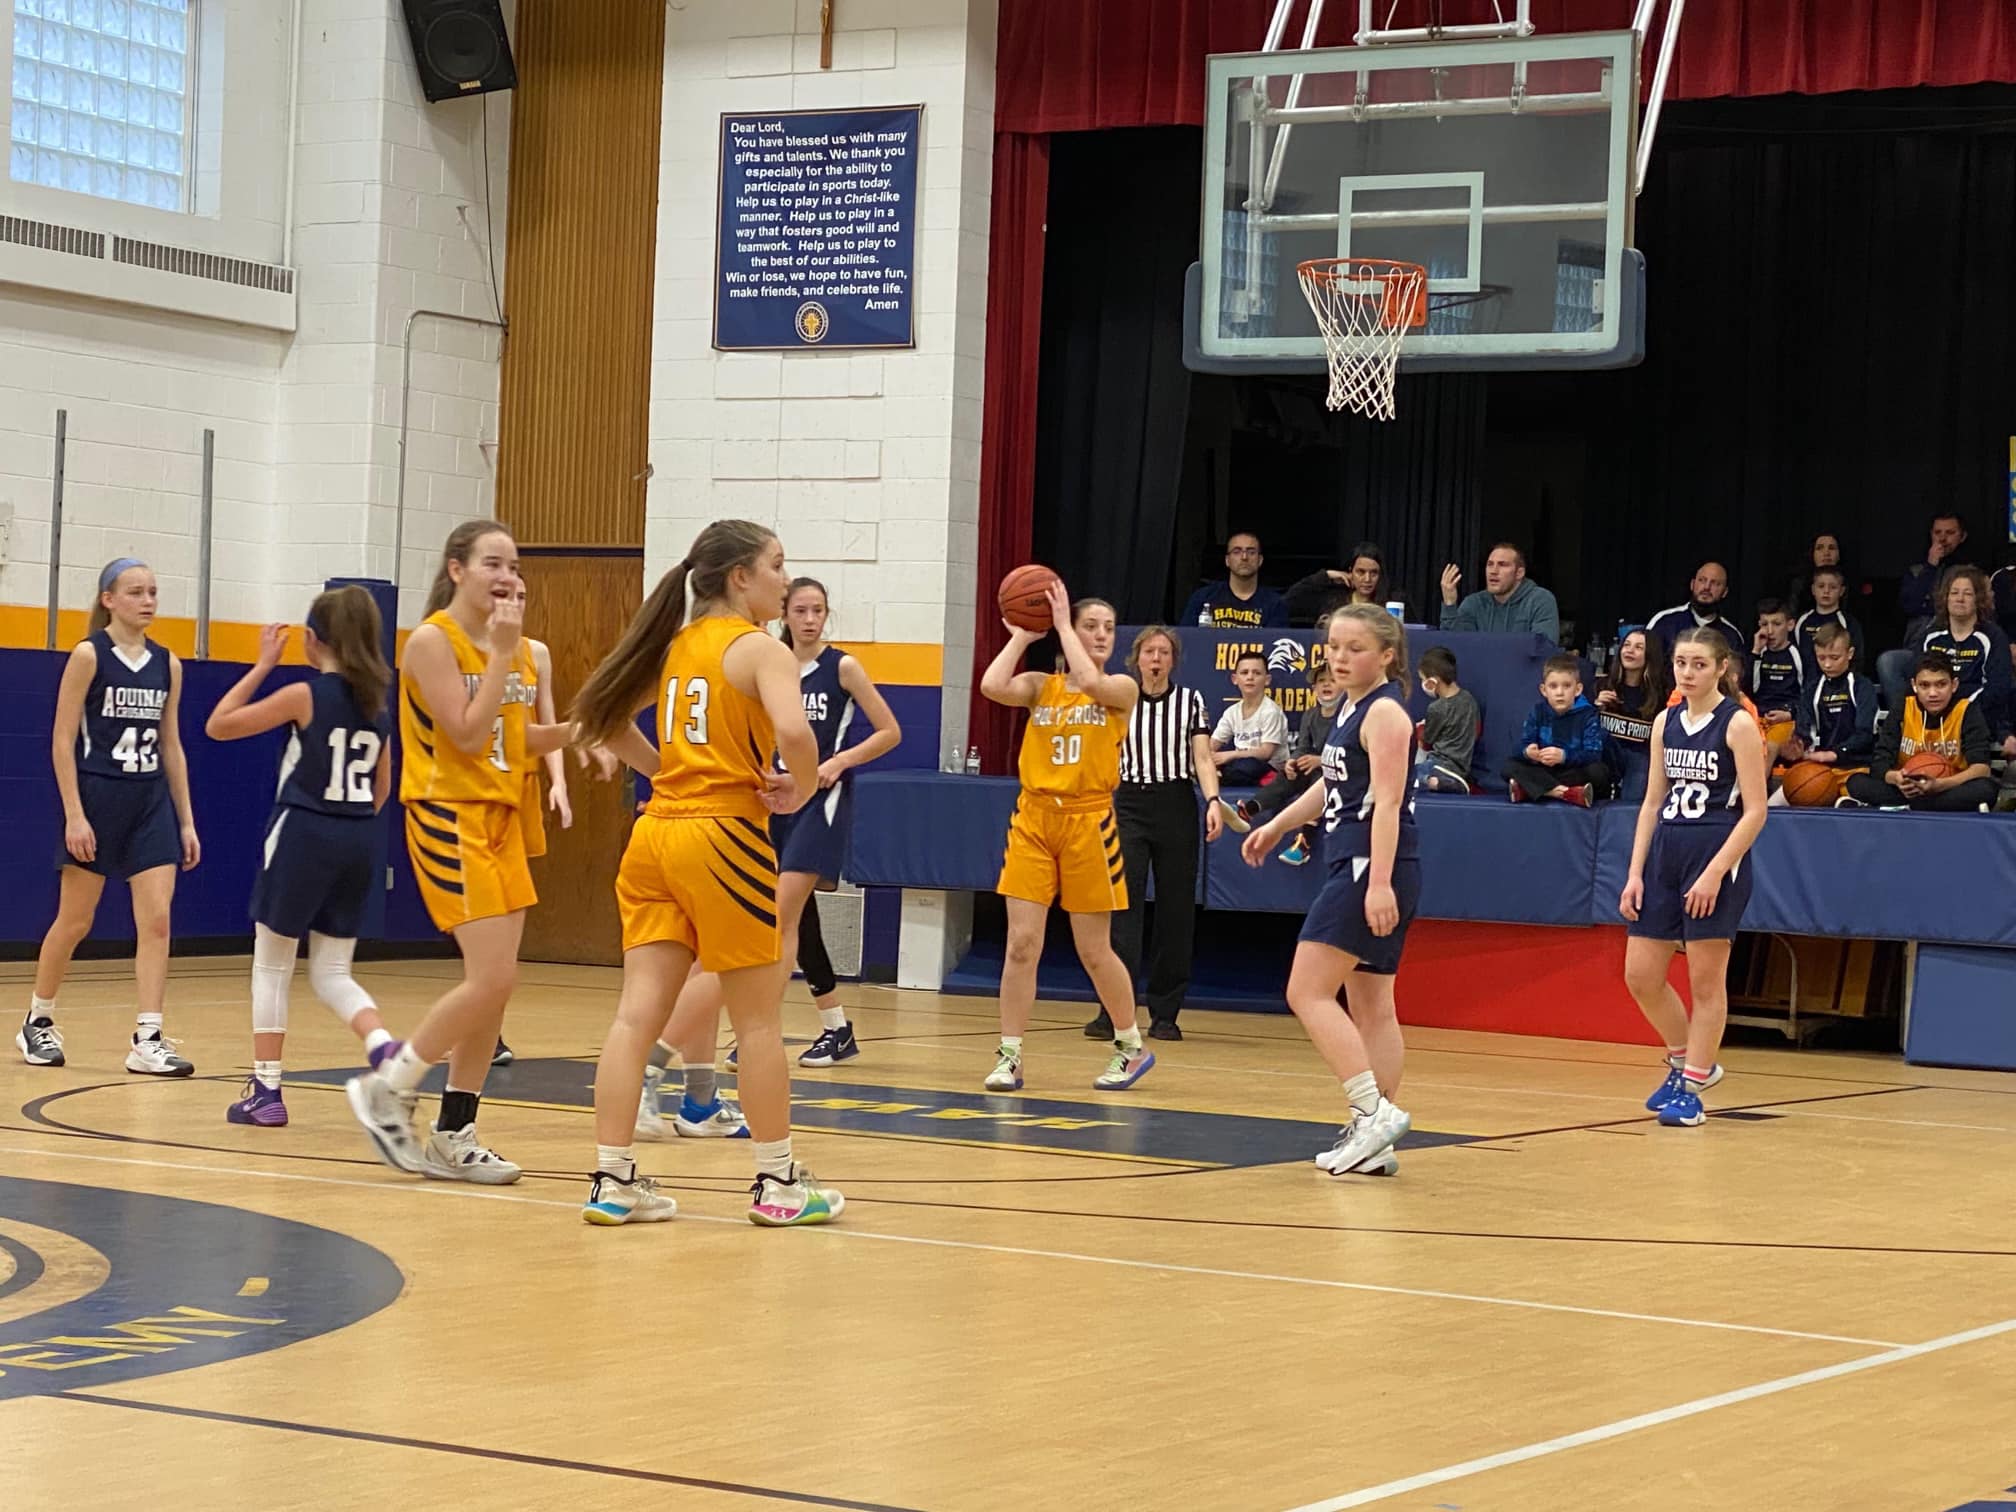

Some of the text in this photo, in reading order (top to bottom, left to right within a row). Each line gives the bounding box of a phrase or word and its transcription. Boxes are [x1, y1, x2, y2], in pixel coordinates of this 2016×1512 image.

[731, 121, 784, 133] Dear Lord,
[735, 132, 907, 147] You have blessed us with many
[735, 147, 905, 164] gifts and talents. We thank you
[746, 162, 892, 179] especially for the ability to
[745, 177, 891, 194] participate in sports today.
[736, 196, 759, 208] Help
[762, 198, 776, 206] us
[780, 197, 792, 206] to
[795, 196, 819, 208] play
[822, 195, 832, 205] in
[844, 191, 900, 204] Christ-like
[740, 213, 782, 222] manner.
[790, 211, 816, 223] Help
[819, 212, 832, 220] us
[835, 210, 845, 219] to
[848, 208, 871, 221] play
[874, 207, 884, 217] in
[736, 222, 899, 239] way that fosters good will and
[738, 238, 896, 253] teamwork. Help us to play to
[751, 253, 879, 267] the best of our abilities.
[726, 272, 746, 282] Win
[749, 274, 760, 282] or
[763, 271, 787, 282] lose,
[809, 270, 837, 282] hope
[840, 270, 851, 280] to
[854, 269, 881, 279] have
[885, 268, 907, 279] fun,
[730, 283, 903, 298] make friends, and celebrate life.
[865, 299, 898, 309] Amen
[1214, 608, 1262, 625] HAWKS
[101, 686, 168, 717] AQUINA
[665, 677, 709, 744] 13
[1066, 704, 1107, 727] CROSS
[111, 727, 158, 772] 42
[1051, 735, 1081, 765] 30
[324, 728, 381, 802] 12
[1664, 748, 1718, 781] QUINAS
